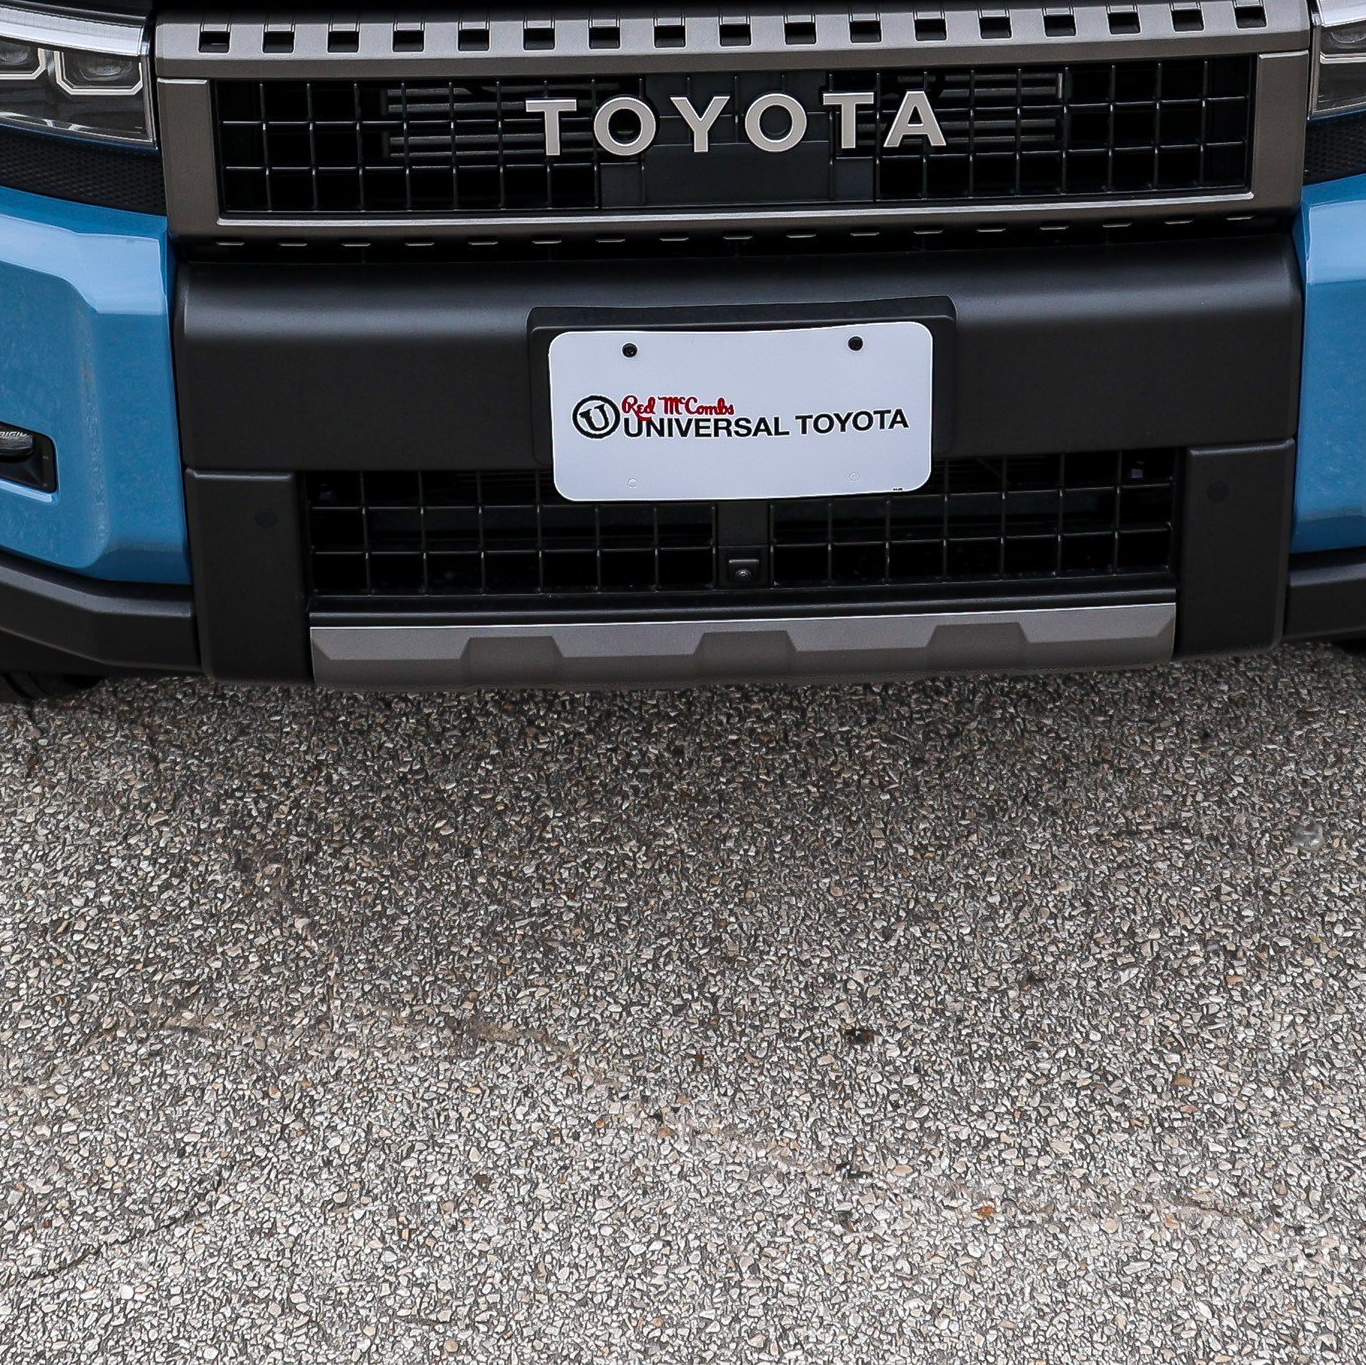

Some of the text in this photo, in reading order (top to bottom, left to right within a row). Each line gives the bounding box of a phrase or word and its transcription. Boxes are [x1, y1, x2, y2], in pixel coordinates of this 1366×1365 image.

[525, 90, 947, 157] TOYOTA
[622, 394, 735, 422] Red McCombs
[623, 408, 910, 438] UNIVERSAL TOYOTA
